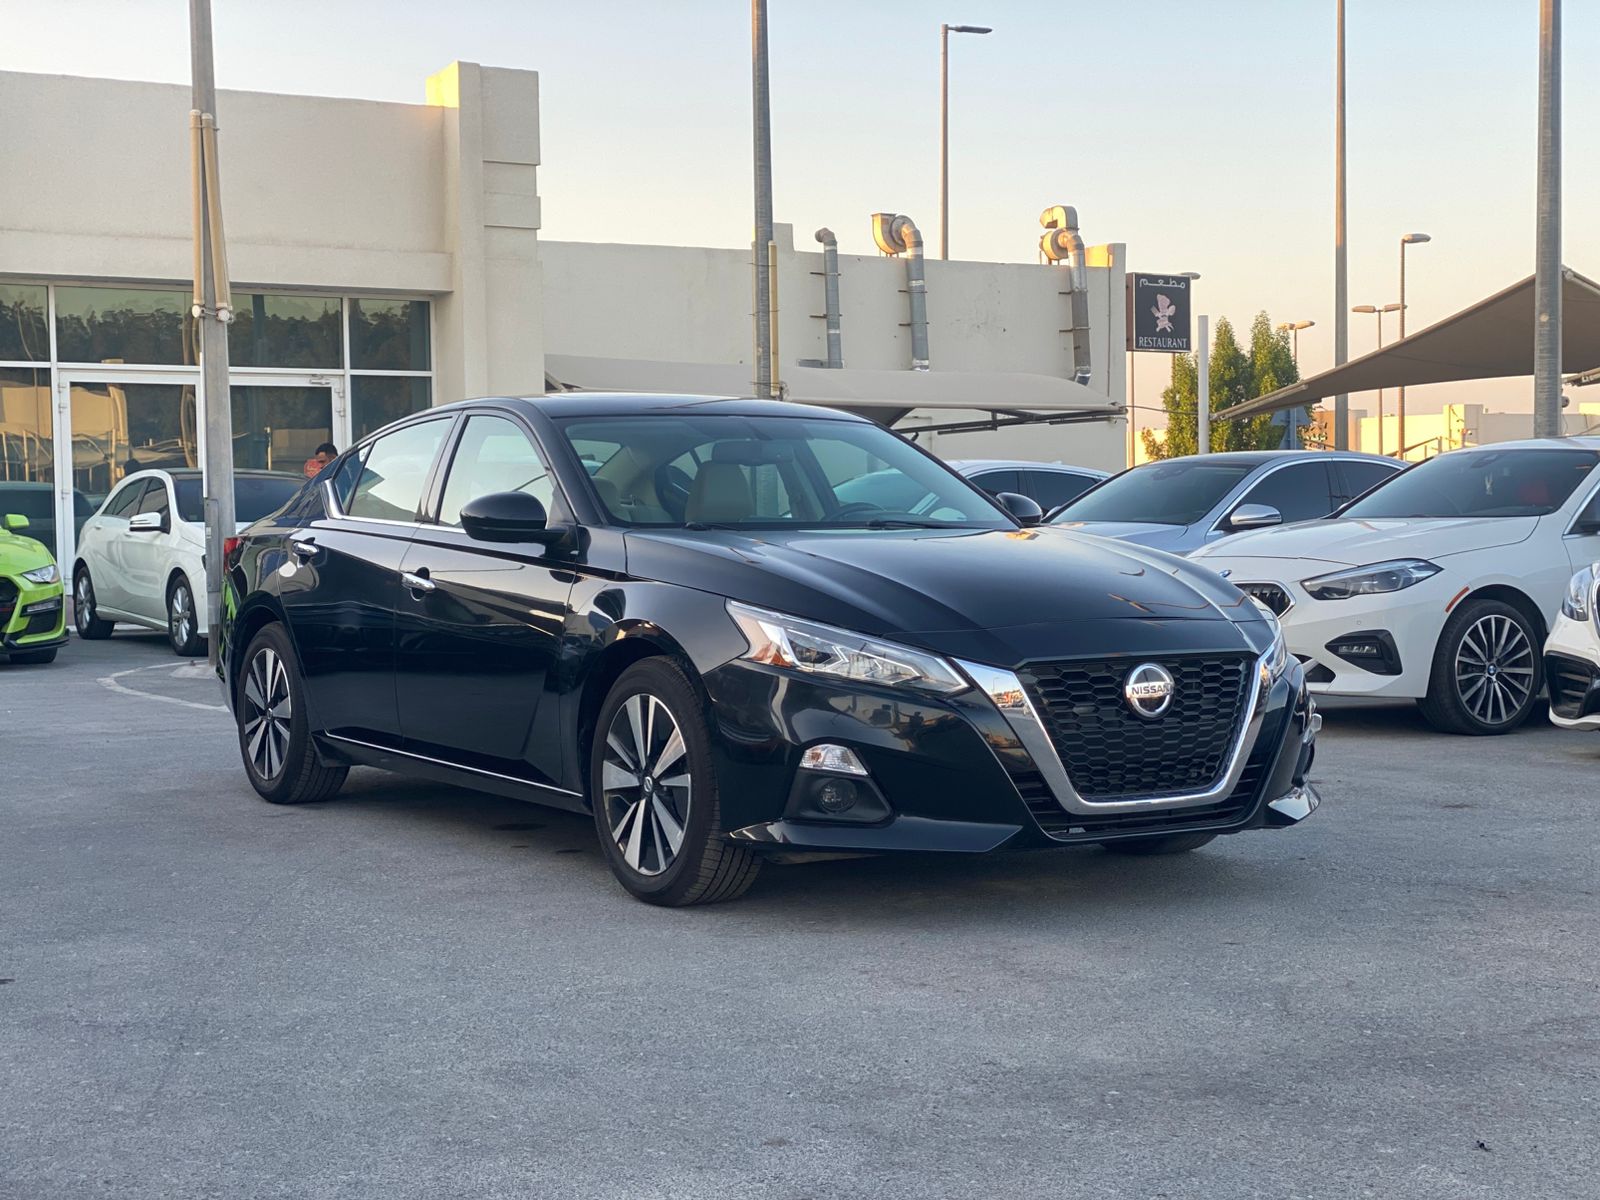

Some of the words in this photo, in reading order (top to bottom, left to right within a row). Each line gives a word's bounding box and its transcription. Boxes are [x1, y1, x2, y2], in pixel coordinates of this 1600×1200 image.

[1139, 278, 1186, 289] مطعم
[1138, 336, 1188, 348] RESTAURANT
[1131, 684, 1170, 695] NISSAN
